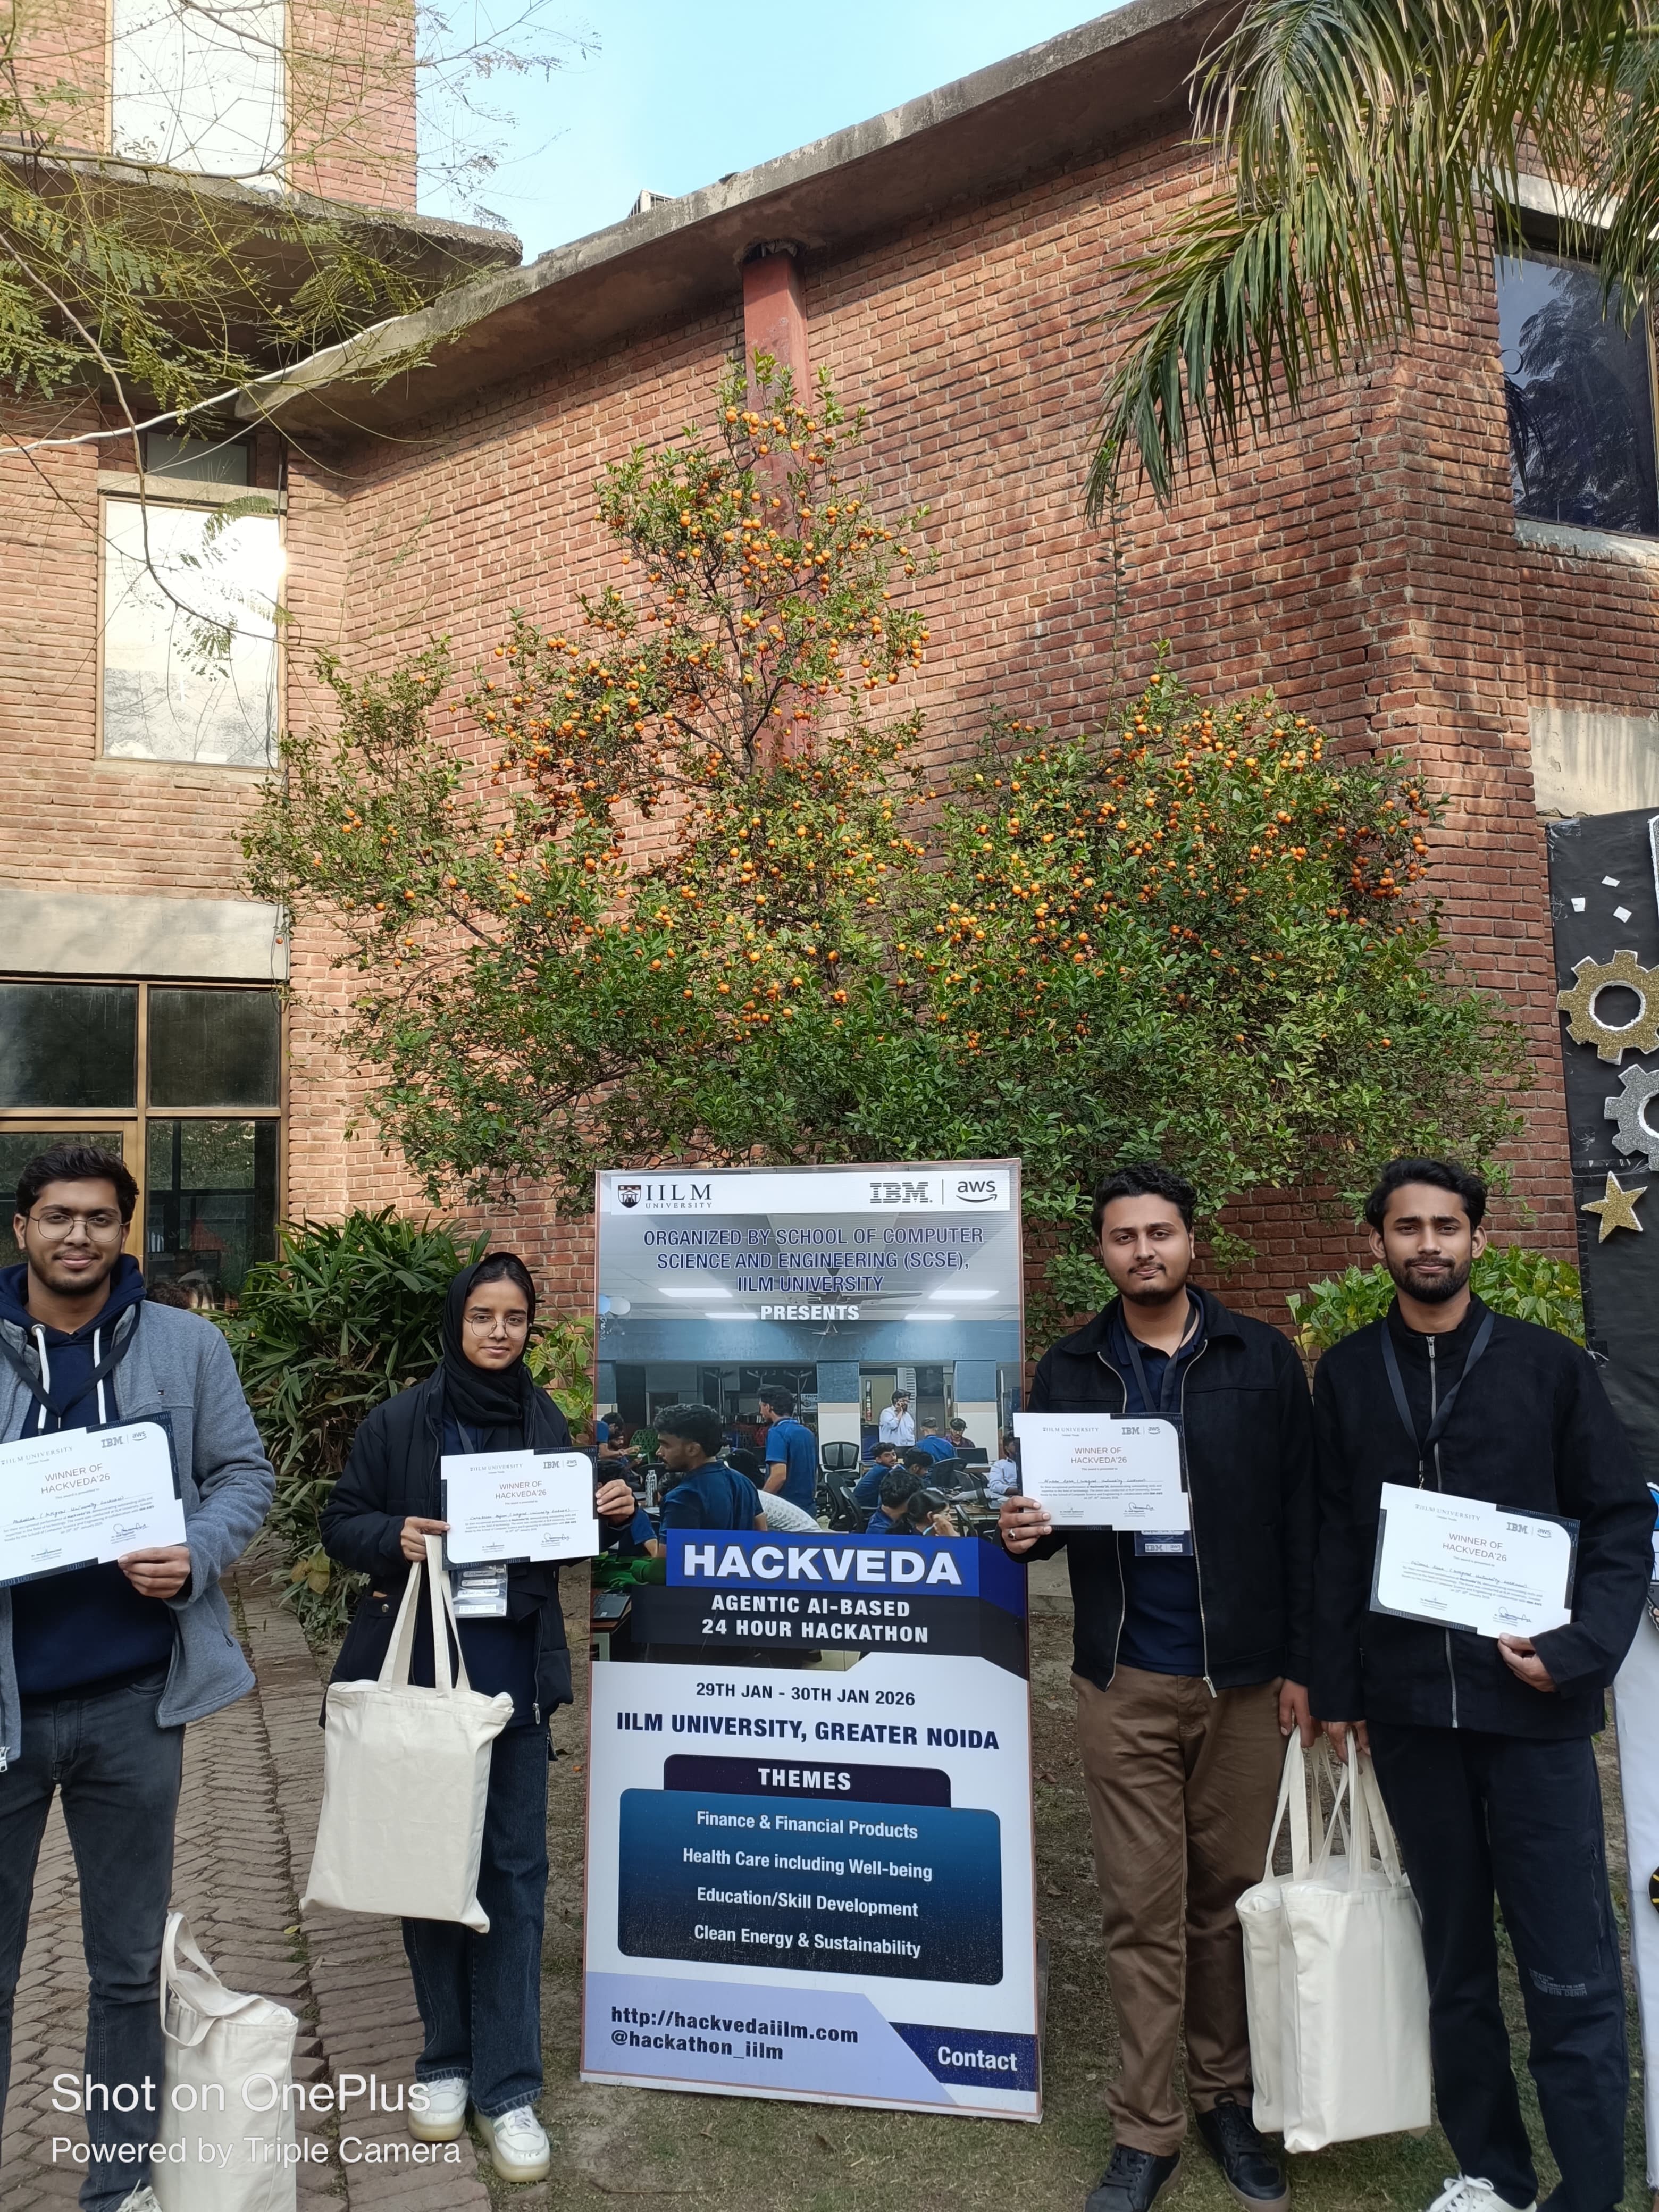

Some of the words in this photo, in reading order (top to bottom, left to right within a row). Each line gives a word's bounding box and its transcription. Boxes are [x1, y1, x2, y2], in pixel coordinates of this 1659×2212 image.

[647, 1184, 712, 1201] IILM
[870, 1182, 929, 1203] IBM
[958, 1180, 996, 1193] aws
[644, 1229, 741, 1246] ORGANIZED
[748, 1229, 770, 1245] BY
[776, 1228, 848, 1245] SCHOOL
[853, 1228, 877, 1245] OF
[883, 1227, 983, 1245] COMPUTER
[657, 1253, 731, 1269] SCIENCE
[735, 1252, 772, 1269] AND
[778, 1252, 897, 1269] ENGINEERING
[904, 1251, 969, 1271] (SCSE),
[738, 1276, 774, 1292] IILM
[780, 1276, 884, 1292] UNIVERSITY
[761, 1305, 860, 1320] PRESENTS
[102, 1436, 123, 1448] IBM
[26, 1446, 73, 1460] UNIVERSITY
[45, 1467, 86, 1482] WINNER
[89, 1463, 103, 1472] OF
[41, 1473, 110, 1494] HACKVEDA'26
[496, 1489, 547, 1499] HACKVEDA'26
[1437, 1509, 1480, 1521] UNIVERSITY
[1506, 1522, 1528, 1534] IBM
[1448, 1533, 1487, 1547] WINNER
[1490, 1540, 1504, 1549] OF
[1443, 1543, 1507, 1562] HACKVEDA'26
[683, 1544, 963, 1586] HACKVEDA
[711, 1594, 800, 1614] AGENTIC
[807, 1597, 910, 1618] AI-BASED
[702, 1619, 727, 1635] 24
[736, 1620, 792, 1638] HOUR
[801, 1622, 929, 1644] HACKATHON
[696, 1682, 735, 1698] 29TH
[741, 1683, 773, 1699] JAN
[791, 1686, 832, 1702] 30TH
[837, 1688, 870, 1703] JAN
[875, 1690, 916, 1706] 2026
[617, 1712, 663, 1731] IILM
[672, 1714, 807, 1742] UNIVERSITY,
[815, 1721, 917, 1745] GREATER
[927, 1728, 1000, 1750] NOIDA
[758, 1768, 851, 1791] THEMES
[697, 1811, 755, 1830] Finance
[760, 1815, 772, 1830] &
[775, 1815, 844, 1834] Financial
[849, 1820, 918, 1839] Products
[683, 1848, 731, 1865] Health
[735, 1851, 770, 1868] Care
[774, 1853, 844, 1875] including
[849, 1858, 933, 1882] Well-being
[697, 1887, 812, 1909] Education/Skill
[817, 1895, 919, 1920] Development
[694, 1925, 736, 1942] Clean
[741, 1928, 793, 1949] Energy
[798, 1932, 810, 1947] &
[814, 1933, 921, 1959] Sustainability
[610, 2006, 859, 2043] http://hackvedaiilm.com
[610, 2030, 784, 2061] @hackathon_iilm
[937, 2046, 1018, 2072] Contact
